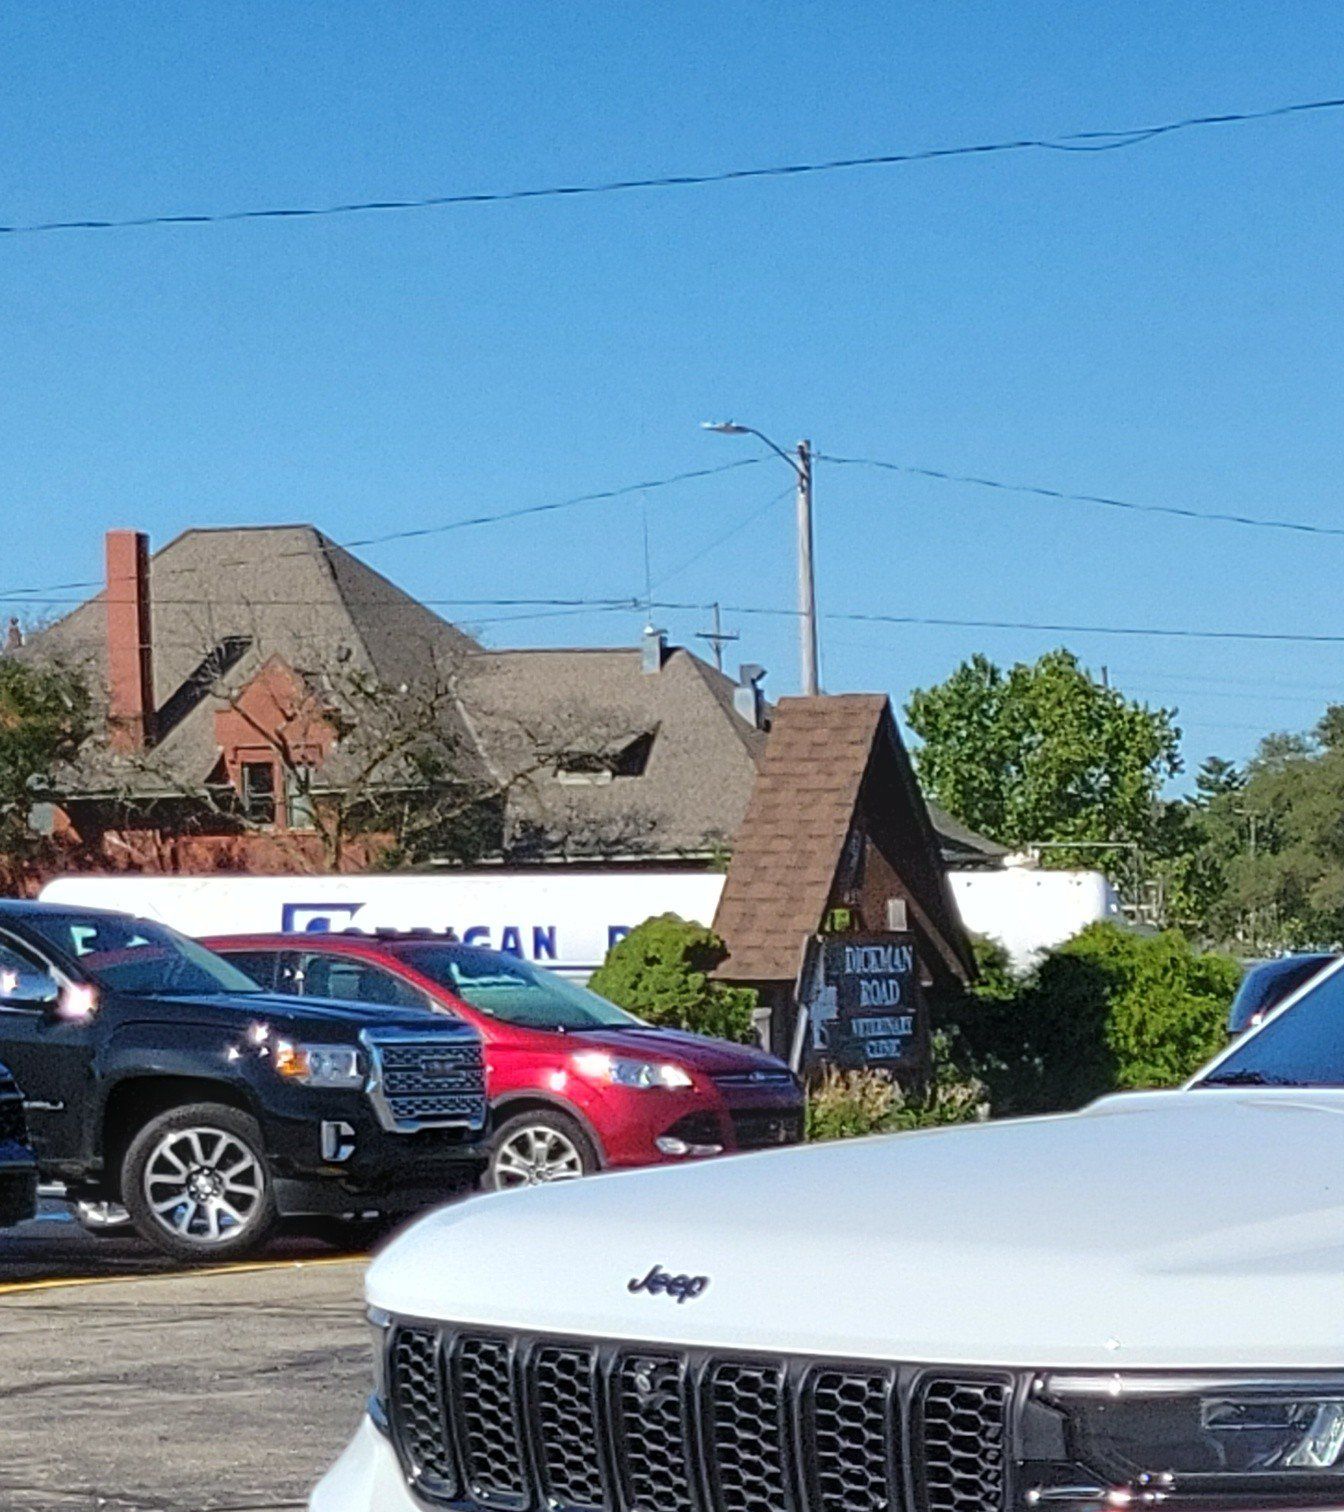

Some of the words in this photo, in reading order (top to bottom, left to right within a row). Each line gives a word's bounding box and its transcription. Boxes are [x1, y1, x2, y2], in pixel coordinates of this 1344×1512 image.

[845, 945, 913, 973] DICKMAN
[860, 979, 900, 1007] ROAD
[627, 1264, 709, 1304] Jeep
